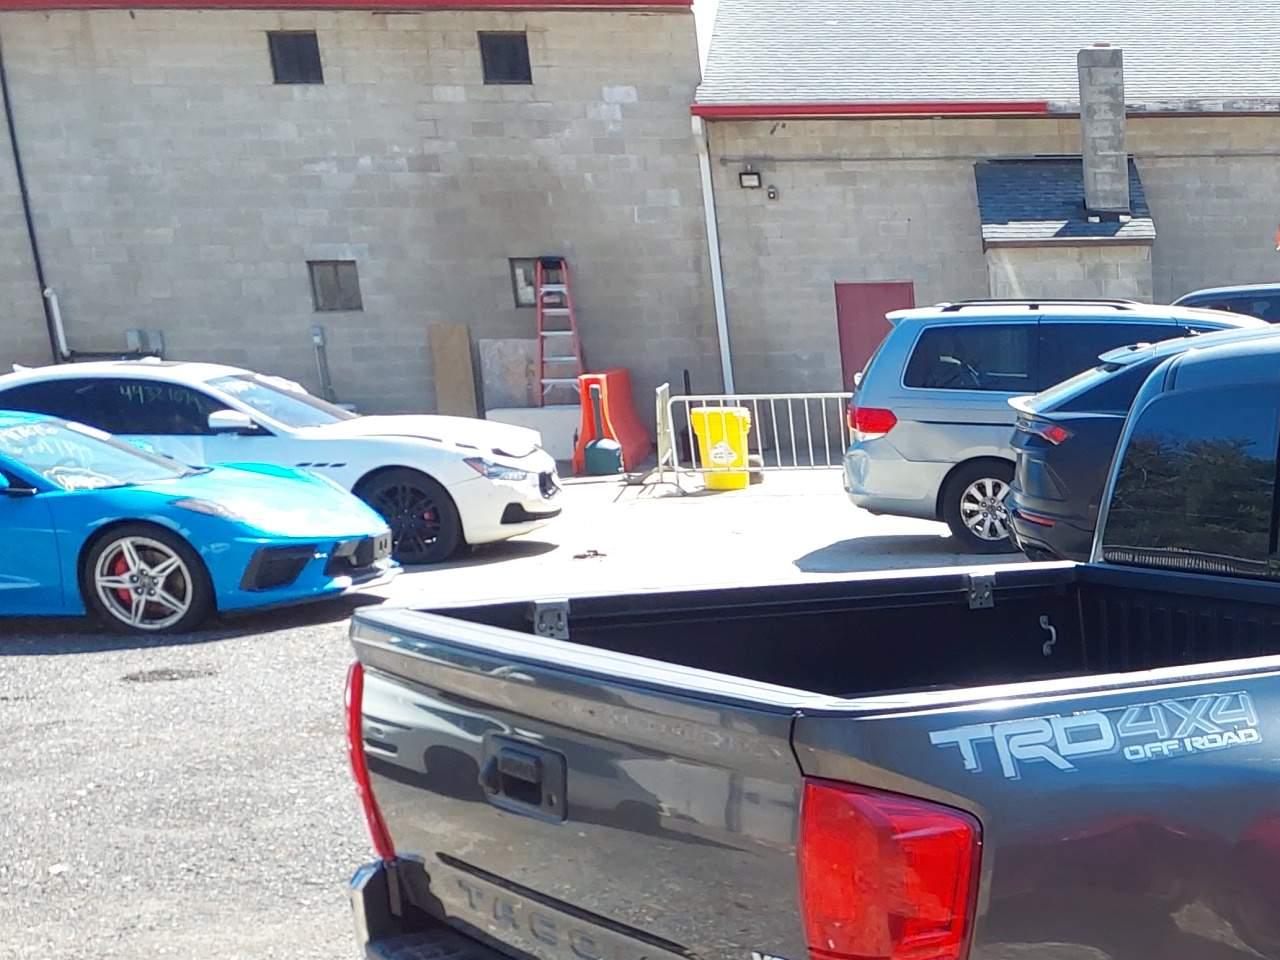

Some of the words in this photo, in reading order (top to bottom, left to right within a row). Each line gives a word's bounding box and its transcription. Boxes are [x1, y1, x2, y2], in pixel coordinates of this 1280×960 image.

[928, 711, 1116, 779] TRD
[1115, 692, 1260, 740] 4X4
[1123, 740, 1181, 762] OFF
[1185, 726, 1261, 753] ROAD
